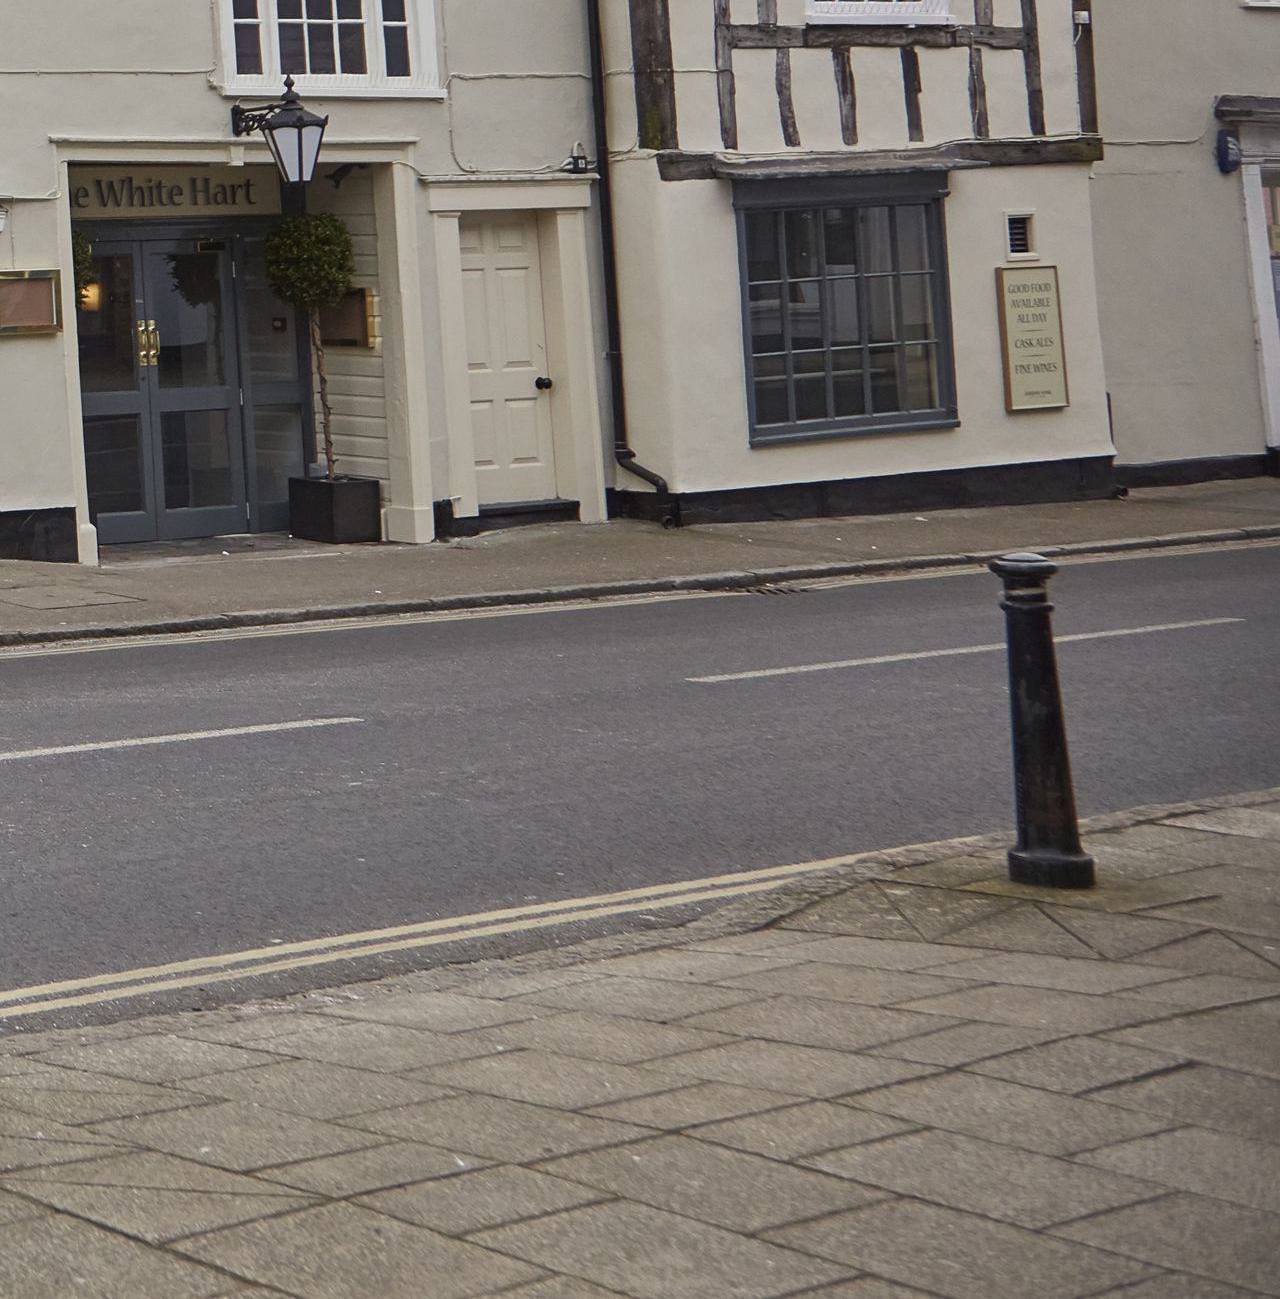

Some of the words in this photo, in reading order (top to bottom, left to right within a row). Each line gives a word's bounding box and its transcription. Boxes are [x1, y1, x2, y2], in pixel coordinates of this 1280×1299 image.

[94, 176, 184, 208] White
[190, 177, 257, 206] Hart
[1008, 284, 1030, 294] GOOD
[1031, 282, 1052, 293] FOOD
[1011, 297, 1051, 309] AVAILABLE
[1017, 313, 1031, 323] ALL
[1032, 312, 1047, 323] DAY
[1014, 338, 1035, 349] CASK
[1036, 337, 1054, 347] ALES
[1014, 364, 1032, 375] FINE
[1033, 362, 1058, 373] WINES
